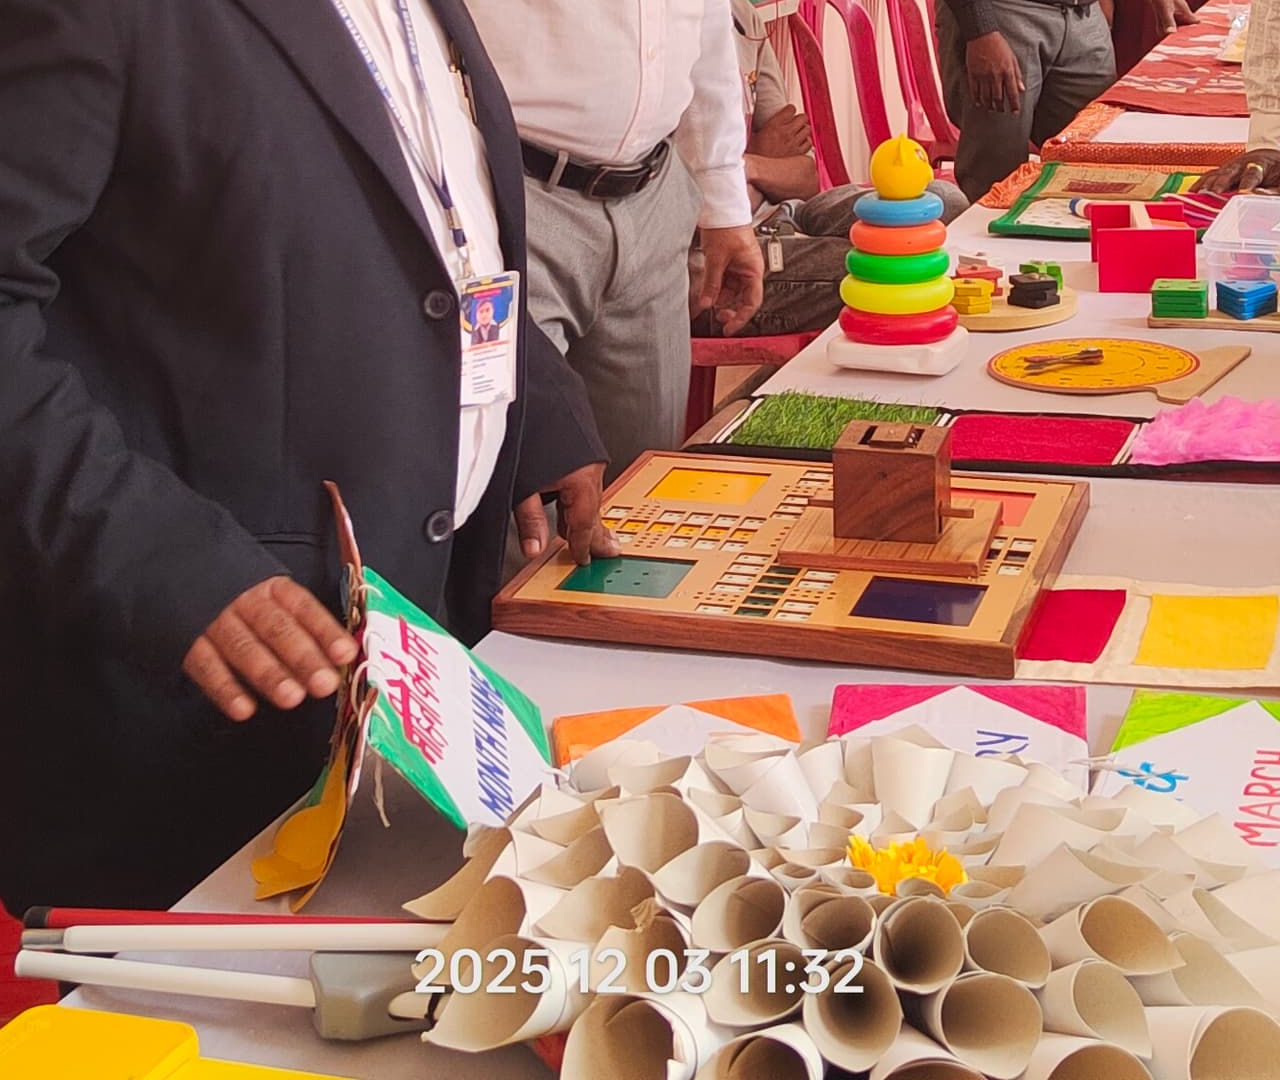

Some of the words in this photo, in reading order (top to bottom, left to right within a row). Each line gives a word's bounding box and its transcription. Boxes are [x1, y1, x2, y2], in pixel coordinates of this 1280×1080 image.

[398, 614, 441, 681] नाम
[469, 665, 508, 741] NAME
[473, 720, 515, 823] MONTH
